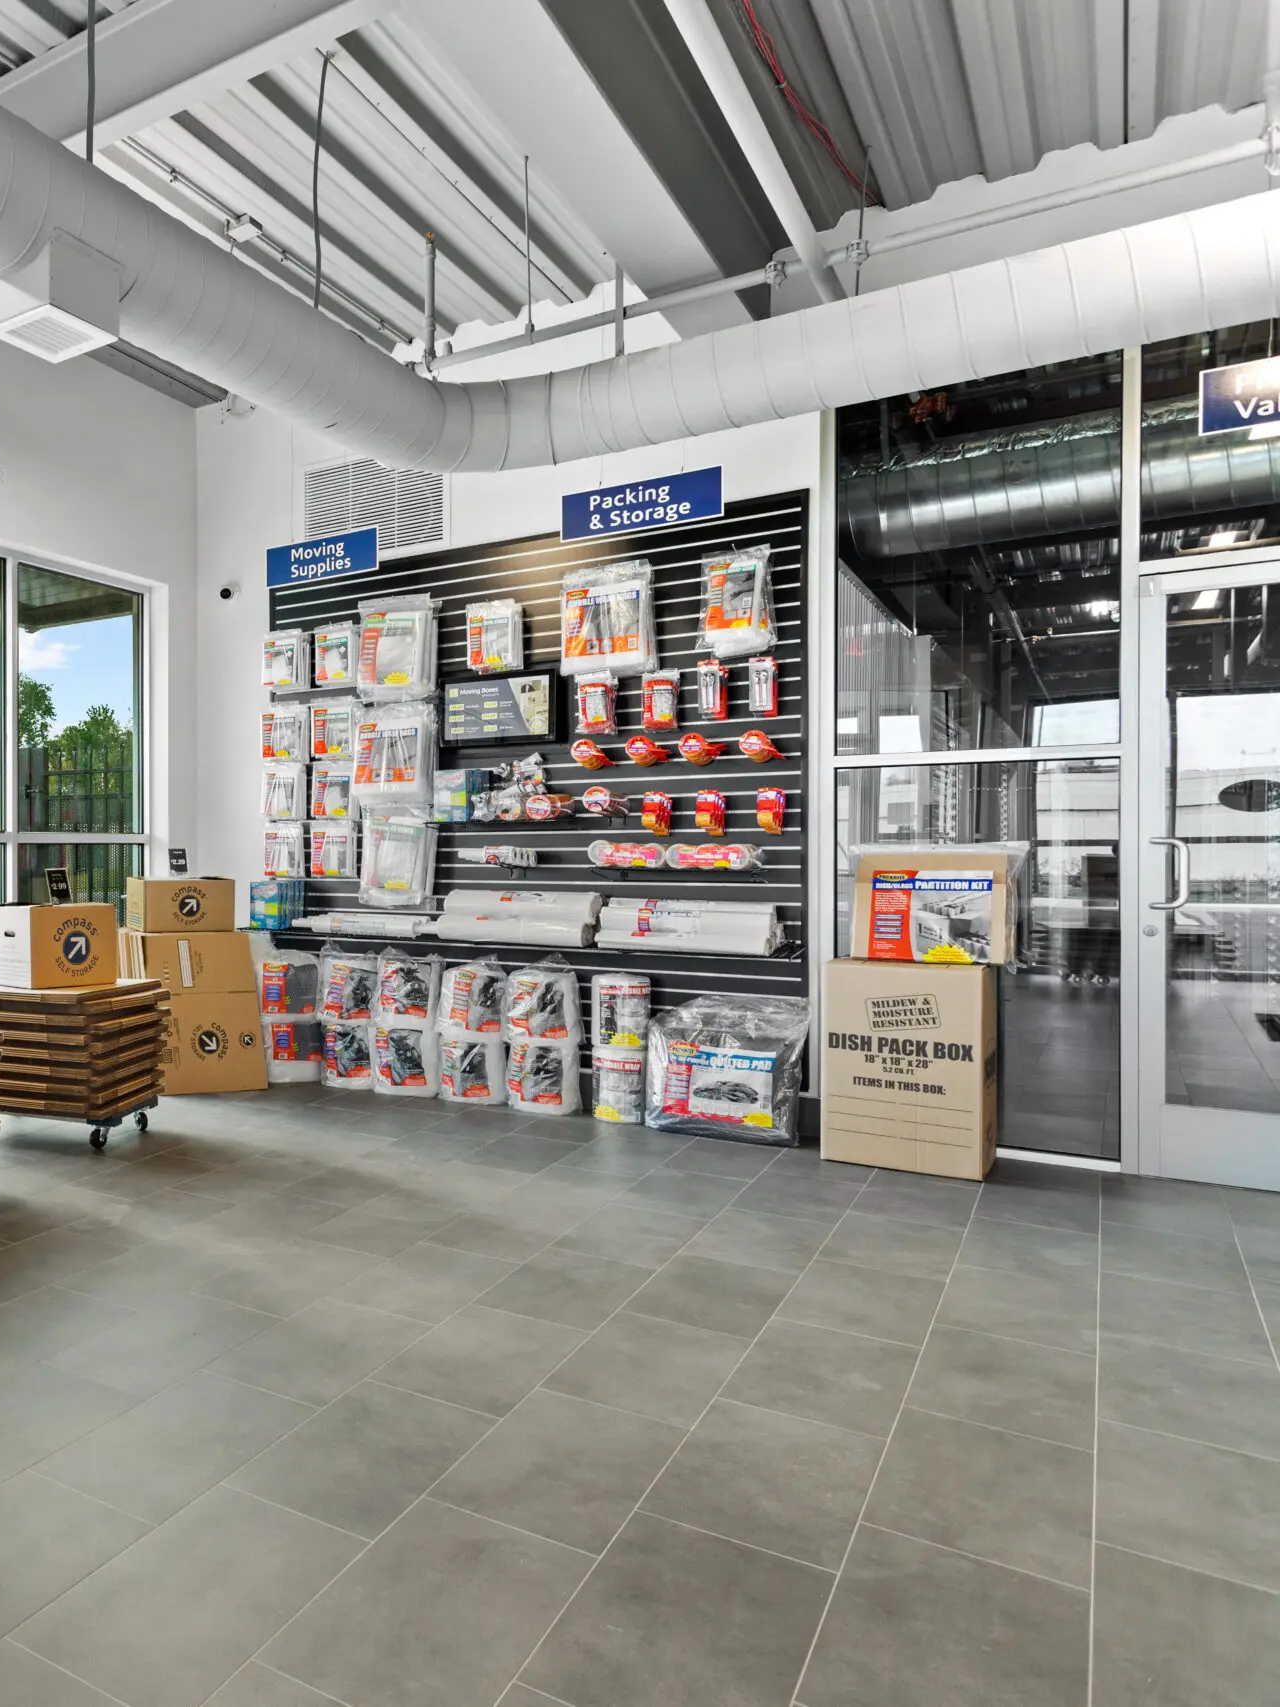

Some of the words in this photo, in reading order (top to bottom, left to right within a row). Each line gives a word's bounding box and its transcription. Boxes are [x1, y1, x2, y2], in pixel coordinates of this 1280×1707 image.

[589, 485, 670, 511] Packing
[589, 515, 604, 530] &
[609, 500, 691, 527] Storage
[290, 541, 345, 562] Moving
[290, 556, 351, 579] Supplies
[459, 688, 481, 696] Moving
[50, 882, 67, 890] $2.99
[914, 880, 969, 890] PARTITION
[970, 880, 989, 890] KIT
[172, 886, 207, 903] compass
[173, 911, 185, 923] SELF
[53, 917, 99, 942] compass
[55, 956, 70, 974] SELF
[71, 954, 99, 977] STORAGE
[871, 997, 919, 1009] MILDEW
[922, 997, 931, 1006] &
[872, 1007, 934, 1019] MOISTURE
[192, 1024, 204, 1036] SELF
[872, 1016, 938, 1029] RESISTANT
[211, 1022, 229, 1060] compass
[828, 1031, 873, 1052] DISH
[877, 1036, 929, 1059] PACK
[933, 1041, 974, 1063] BOX
[751, 1058, 772, 1071] PAD
[864, 1054, 880, 1064] 18"
[881, 1057, 887, 1065] x
[890, 1056, 906, 1066] 18"
[915, 1059, 933, 1069] 28"
[853, 1076, 883, 1088] ITEMS
[885, 1080, 896, 1089] IN
[897, 1081, 921, 1093] THIS
[922, 1083, 946, 1096] BOX:
